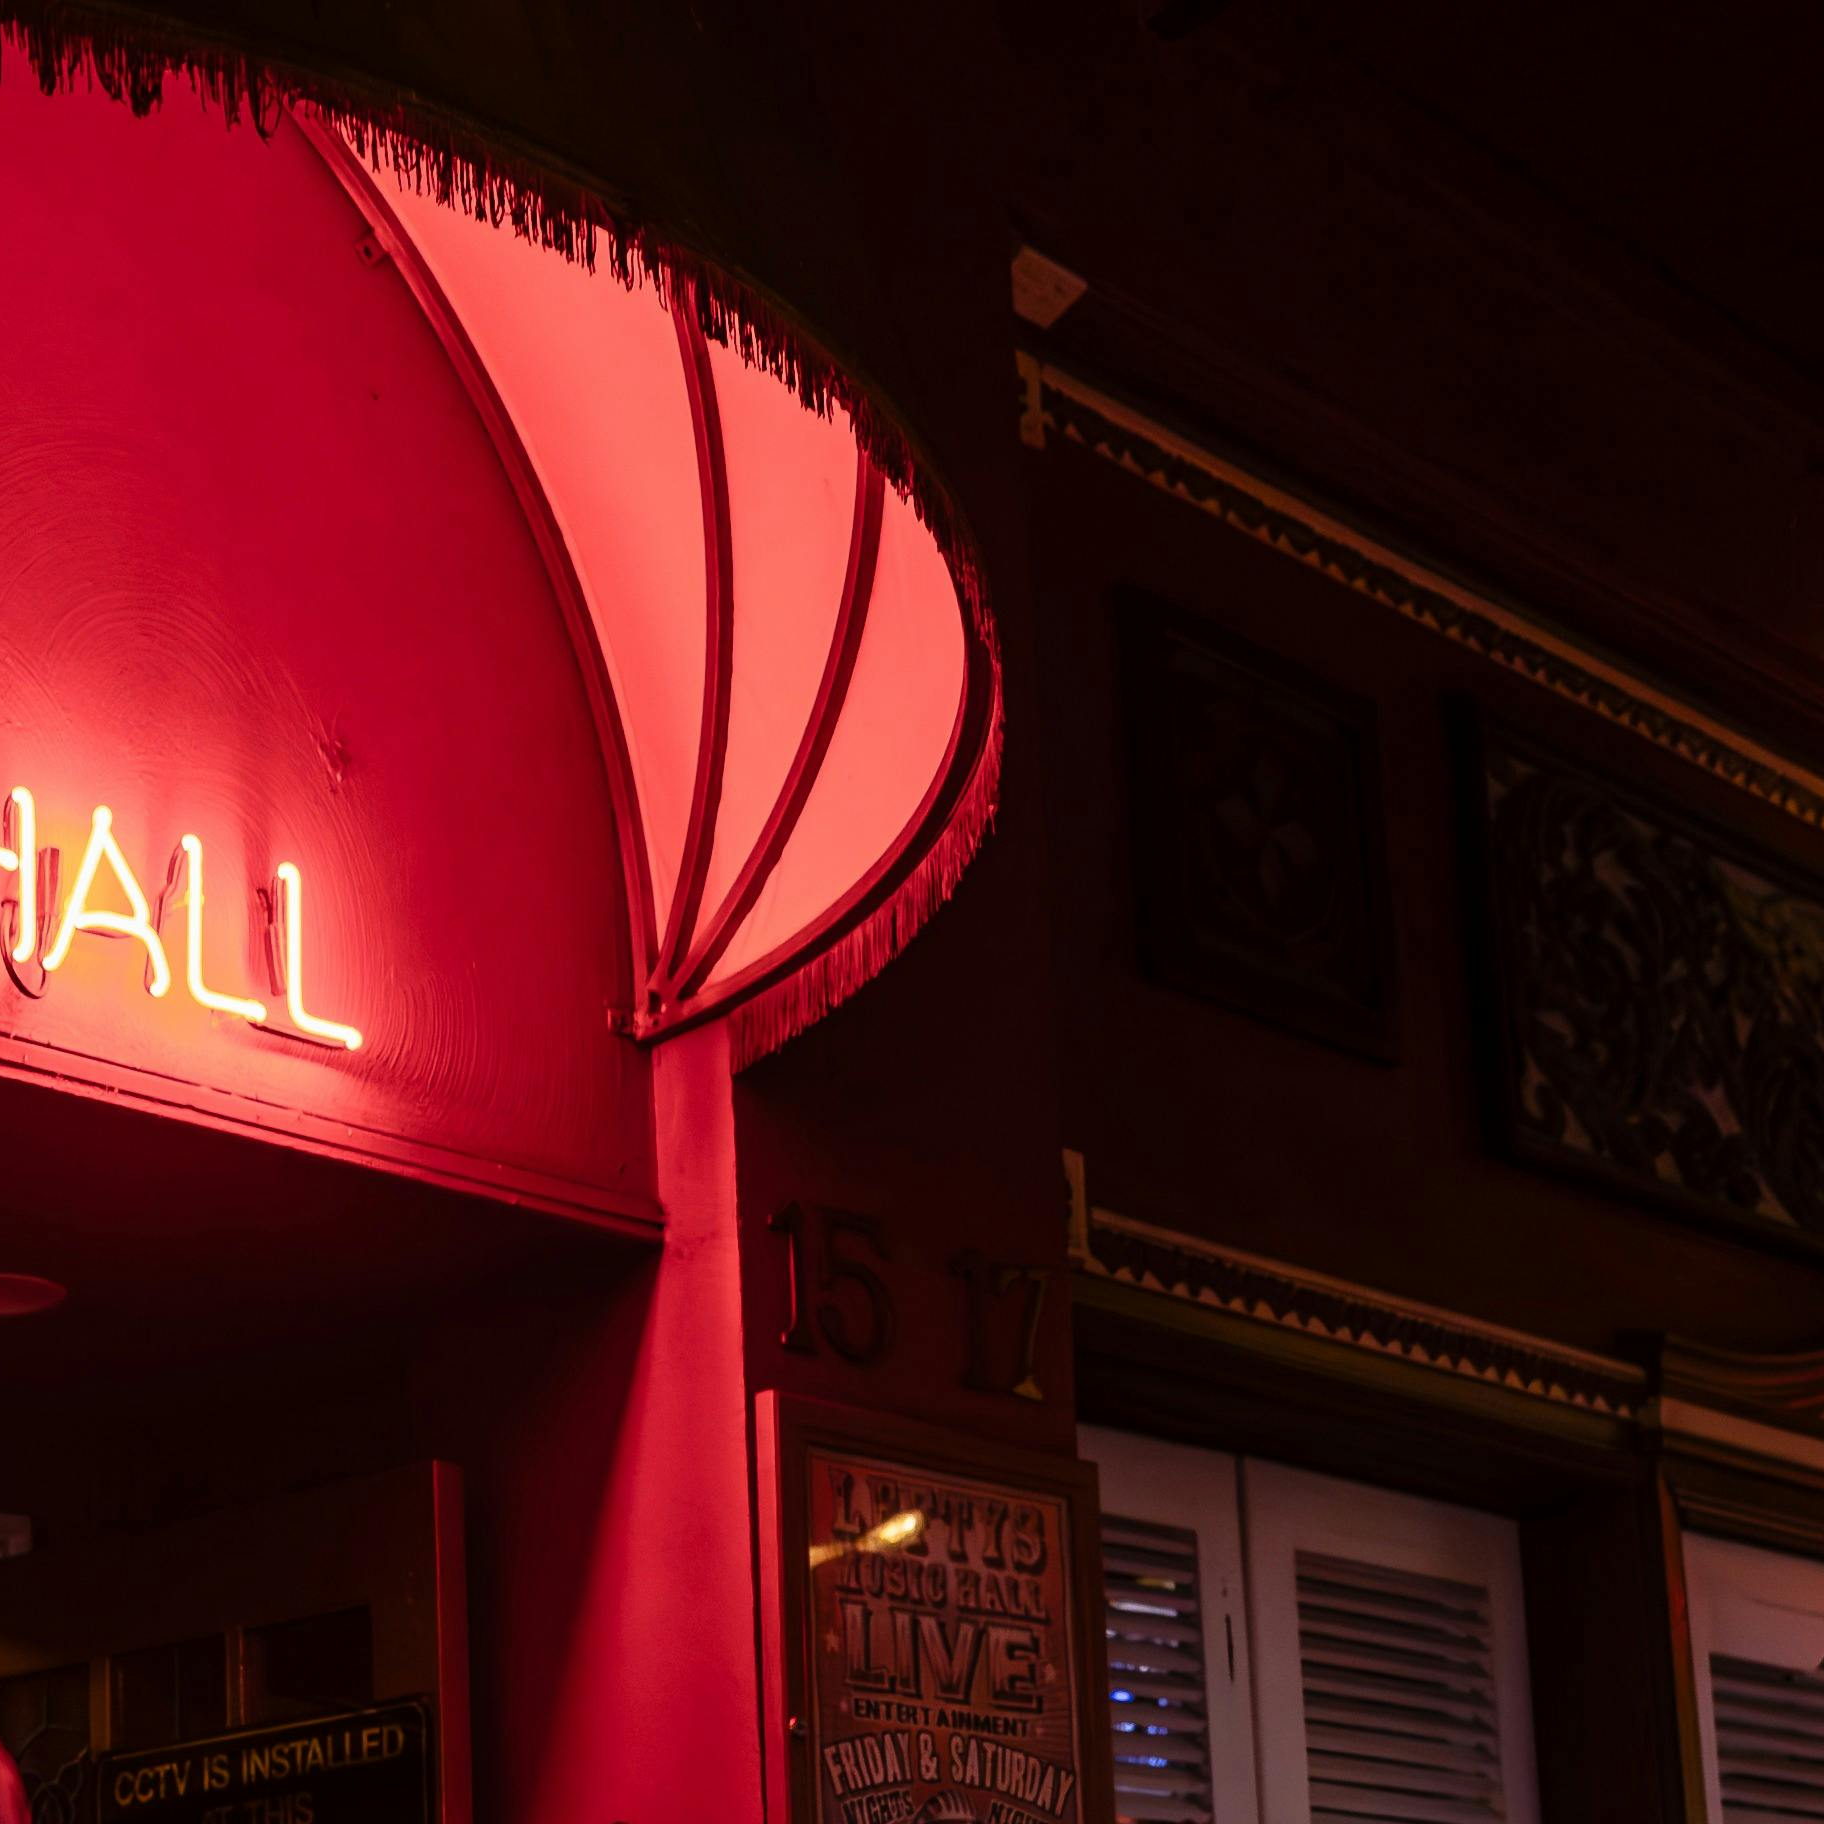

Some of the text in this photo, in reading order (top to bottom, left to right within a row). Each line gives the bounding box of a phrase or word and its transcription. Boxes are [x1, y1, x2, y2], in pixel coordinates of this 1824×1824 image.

[956, 1570, 1049, 1623] HALL
[841, 1597, 1042, 1712] LIVE
[853, 1697, 1029, 1736] ENTERTAINMENT
[113, 1725, 406, 1807] CCTV IS INSTALLED
[823, 1730, 1074, 1818] FRIDAY & SATURDAY
